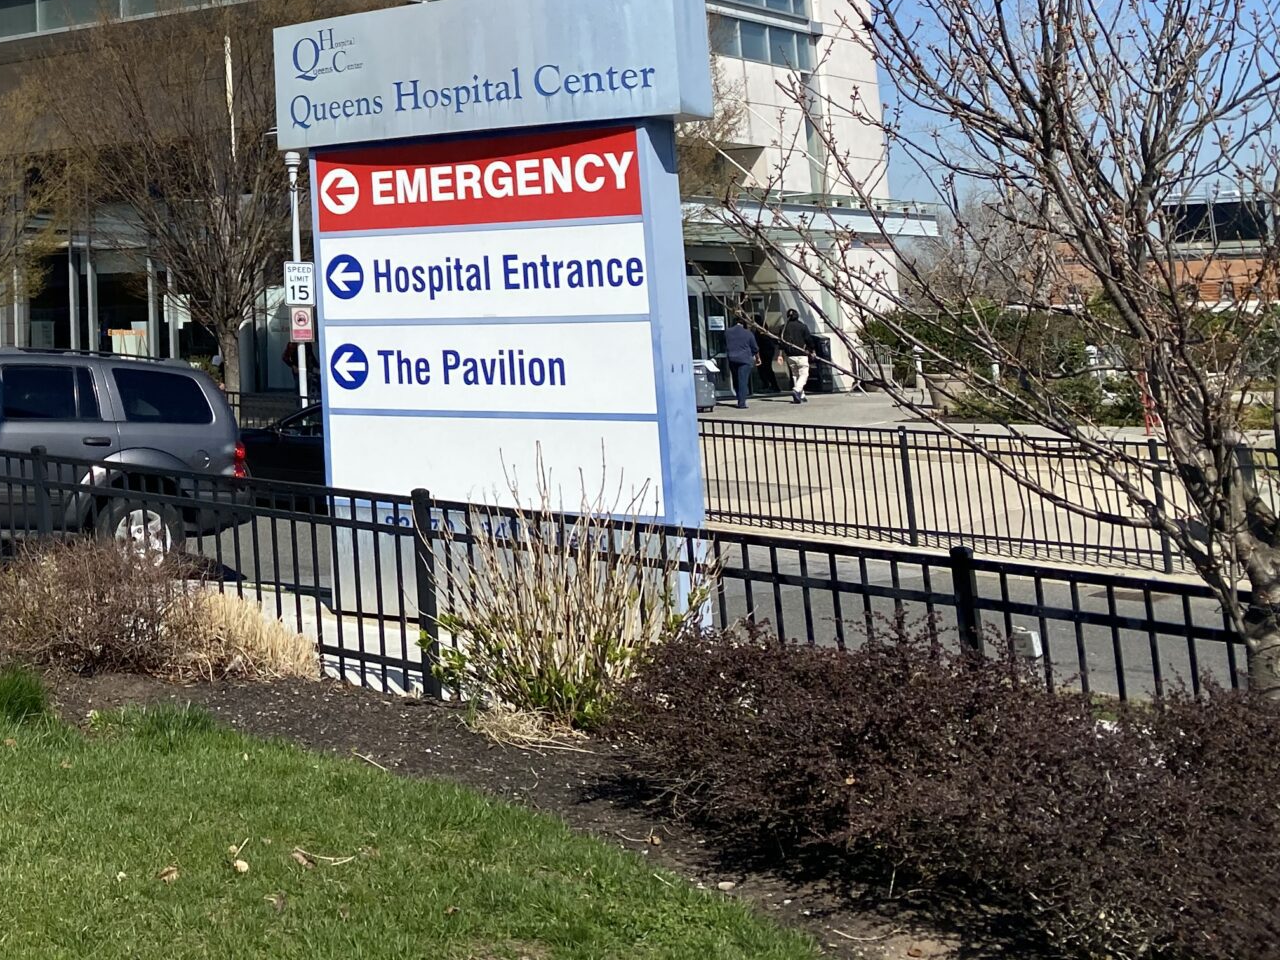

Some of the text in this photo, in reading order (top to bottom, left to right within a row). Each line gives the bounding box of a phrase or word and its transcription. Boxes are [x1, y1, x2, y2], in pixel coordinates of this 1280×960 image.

[290, 64, 656, 129] Queens Hospital Center
[370, 151, 634, 205] EMERGENCY
[290, 285, 310, 300] 15
[373, 254, 644, 300] Hospital Entrance
[377, 349, 567, 386] The Pavilion
